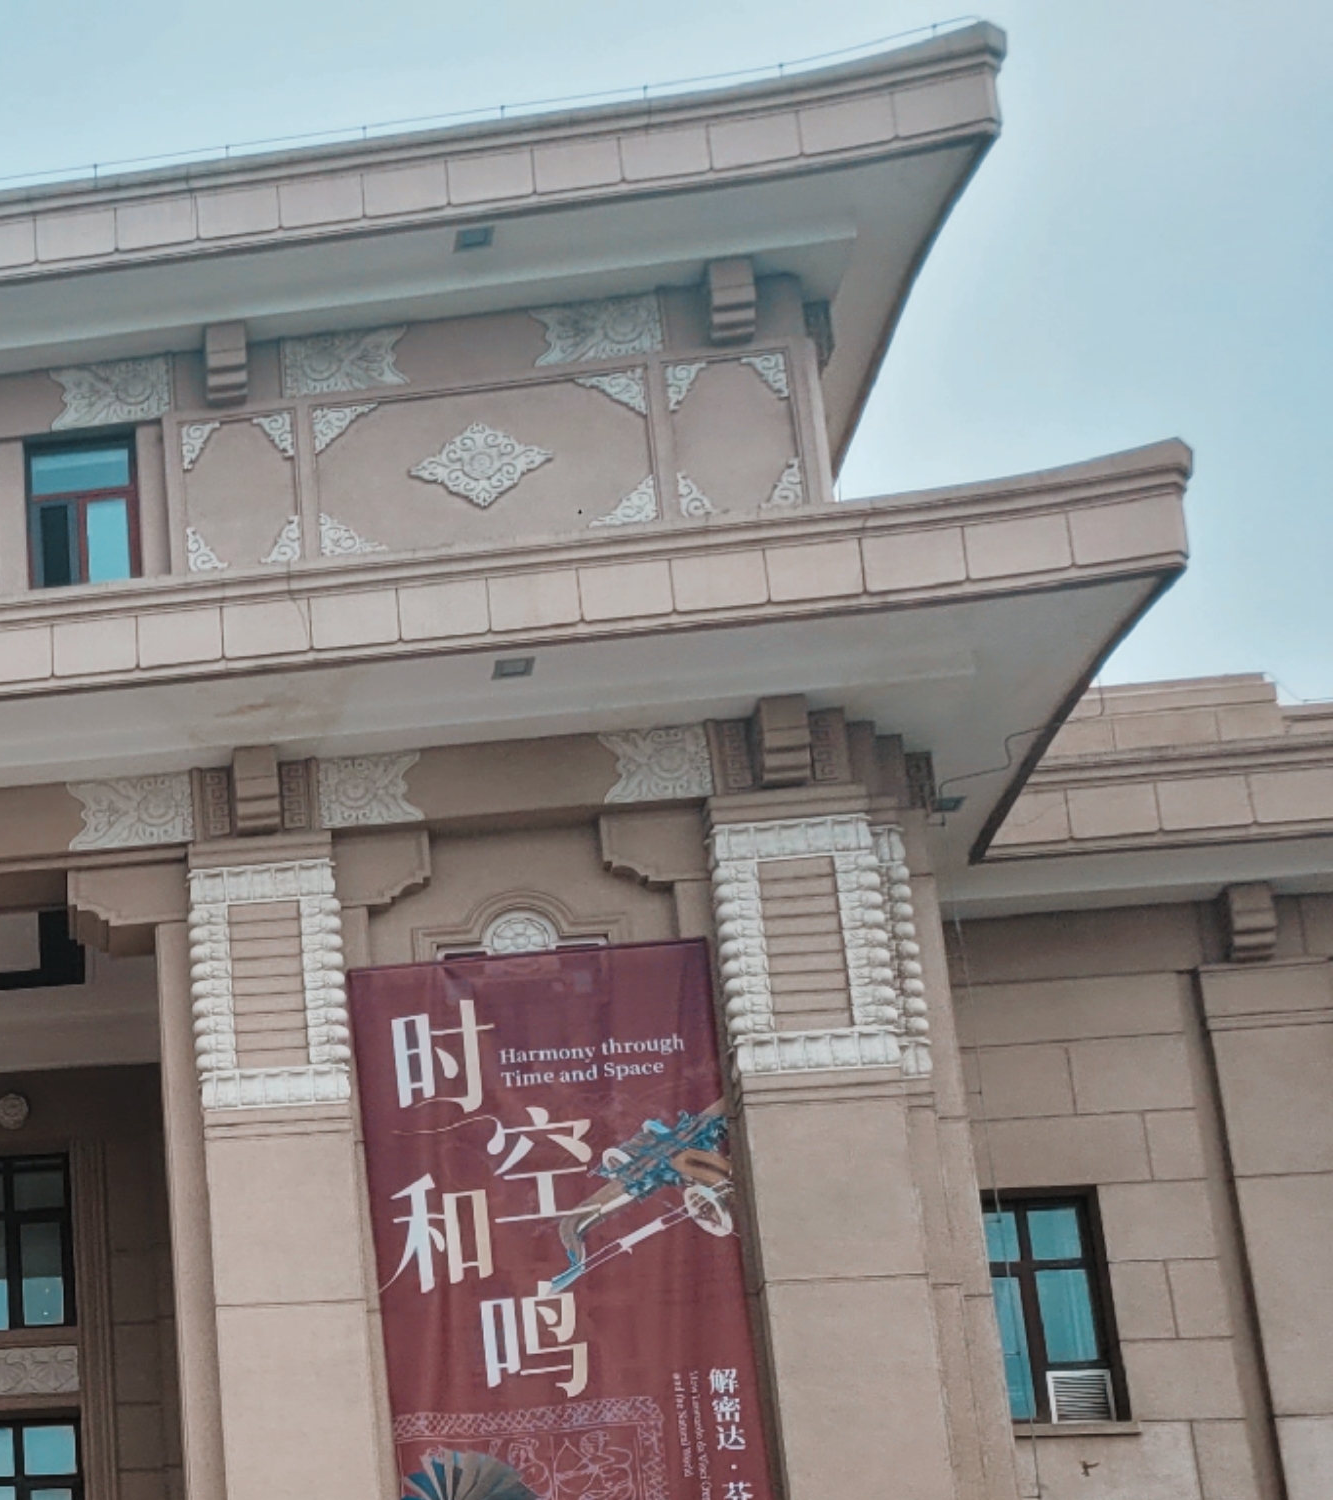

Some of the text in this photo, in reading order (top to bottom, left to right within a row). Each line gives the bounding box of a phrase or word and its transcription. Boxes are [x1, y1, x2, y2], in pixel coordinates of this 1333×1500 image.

[499, 1033, 685, 1064] Harmony through
[500, 1061, 664, 1088] Time and Space
